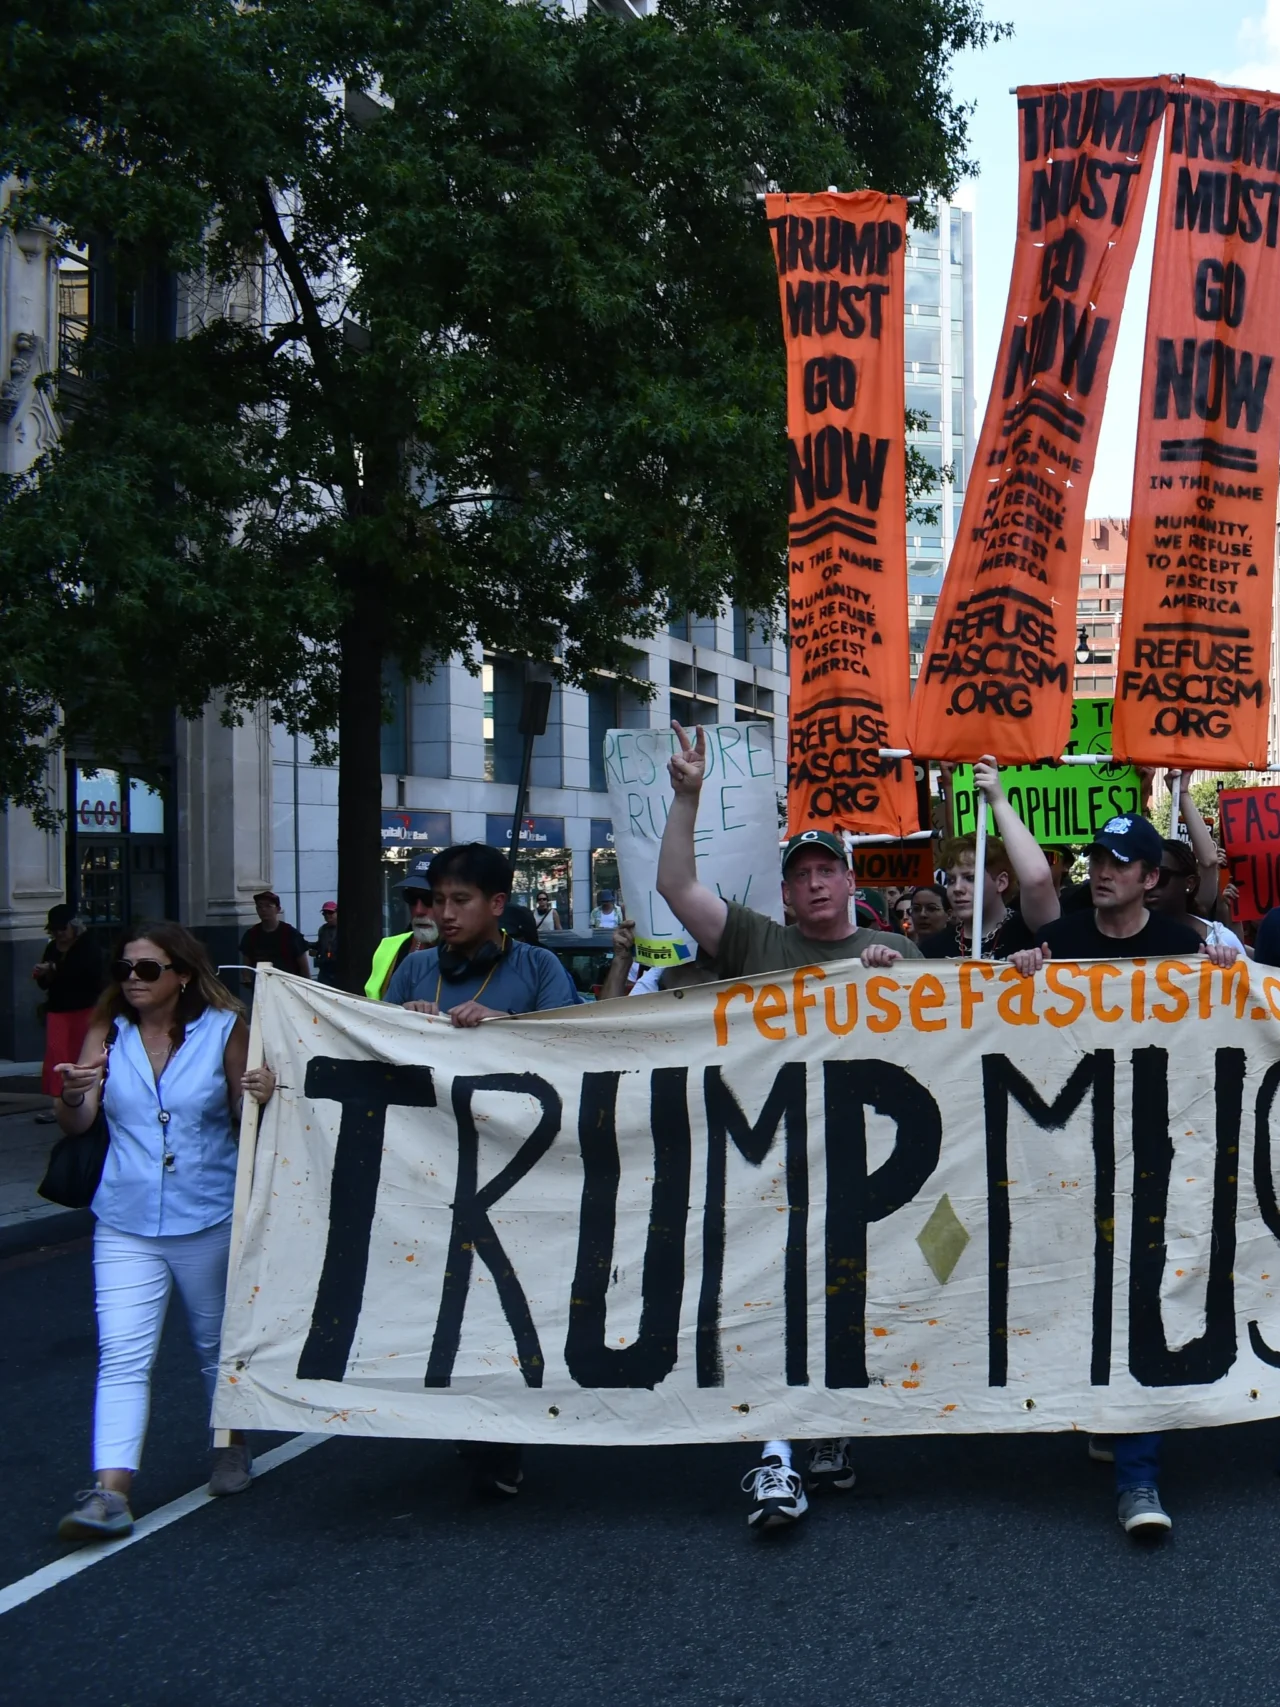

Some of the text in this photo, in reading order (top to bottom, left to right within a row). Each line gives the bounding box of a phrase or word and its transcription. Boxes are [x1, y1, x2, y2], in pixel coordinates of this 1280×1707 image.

[1017, 87, 1168, 162] TRUMP
[767, 214, 902, 277] TRUMP
[786, 280, 890, 339] MUST
[1195, 258, 1246, 329] GO
[1002, 296, 1110, 400] NOW
[804, 354, 857, 415] GO
[1153, 337, 1274, 433] NOW
[788, 424, 890, 513] NOW
[1038, 435, 1083, 475] NAME
[1150, 476, 1173, 490] IN
[1213, 480, 1264, 501] NAME
[1197, 496, 1215, 512] OF
[1154, 534, 1252, 557] WE REFUSE
[1155, 515, 1252, 540] HUMANITY,
[809, 546, 884, 573] THE NAME
[821, 563, 843, 581] OF
[1146, 554, 1258, 576] TO ACCEPT A
[1166, 574, 1238, 594] FASCIST
[791, 601, 876, 631] WE REFUSE
[1159, 593, 1241, 614] AMERICA
[812, 620, 882, 645] ACCEPT A
[943, 603, 1057, 657] REFUSE
[804, 639, 867, 665] FASCIST
[925, 643, 1068, 694] FASCISM
[1134, 638, 1254, 674] REFUSE
[802, 658, 871, 685] AMERICA
[1122, 671, 1263, 708] FASCISM
[946, 681, 1032, 718] .ORG
[791, 714, 890, 758] REFUSE
[1151, 707, 1231, 738] .ORG
[788, 747, 902, 791] FASCISM
[80, 799, 128, 827] COSI
[628, 785, 747, 840] RUE
[808, 782, 880, 820] .ORG
[413, 832, 428, 840] Bank
[801, 831, 818, 840] C
[297, 1055, 943, 1390] TRUMP
